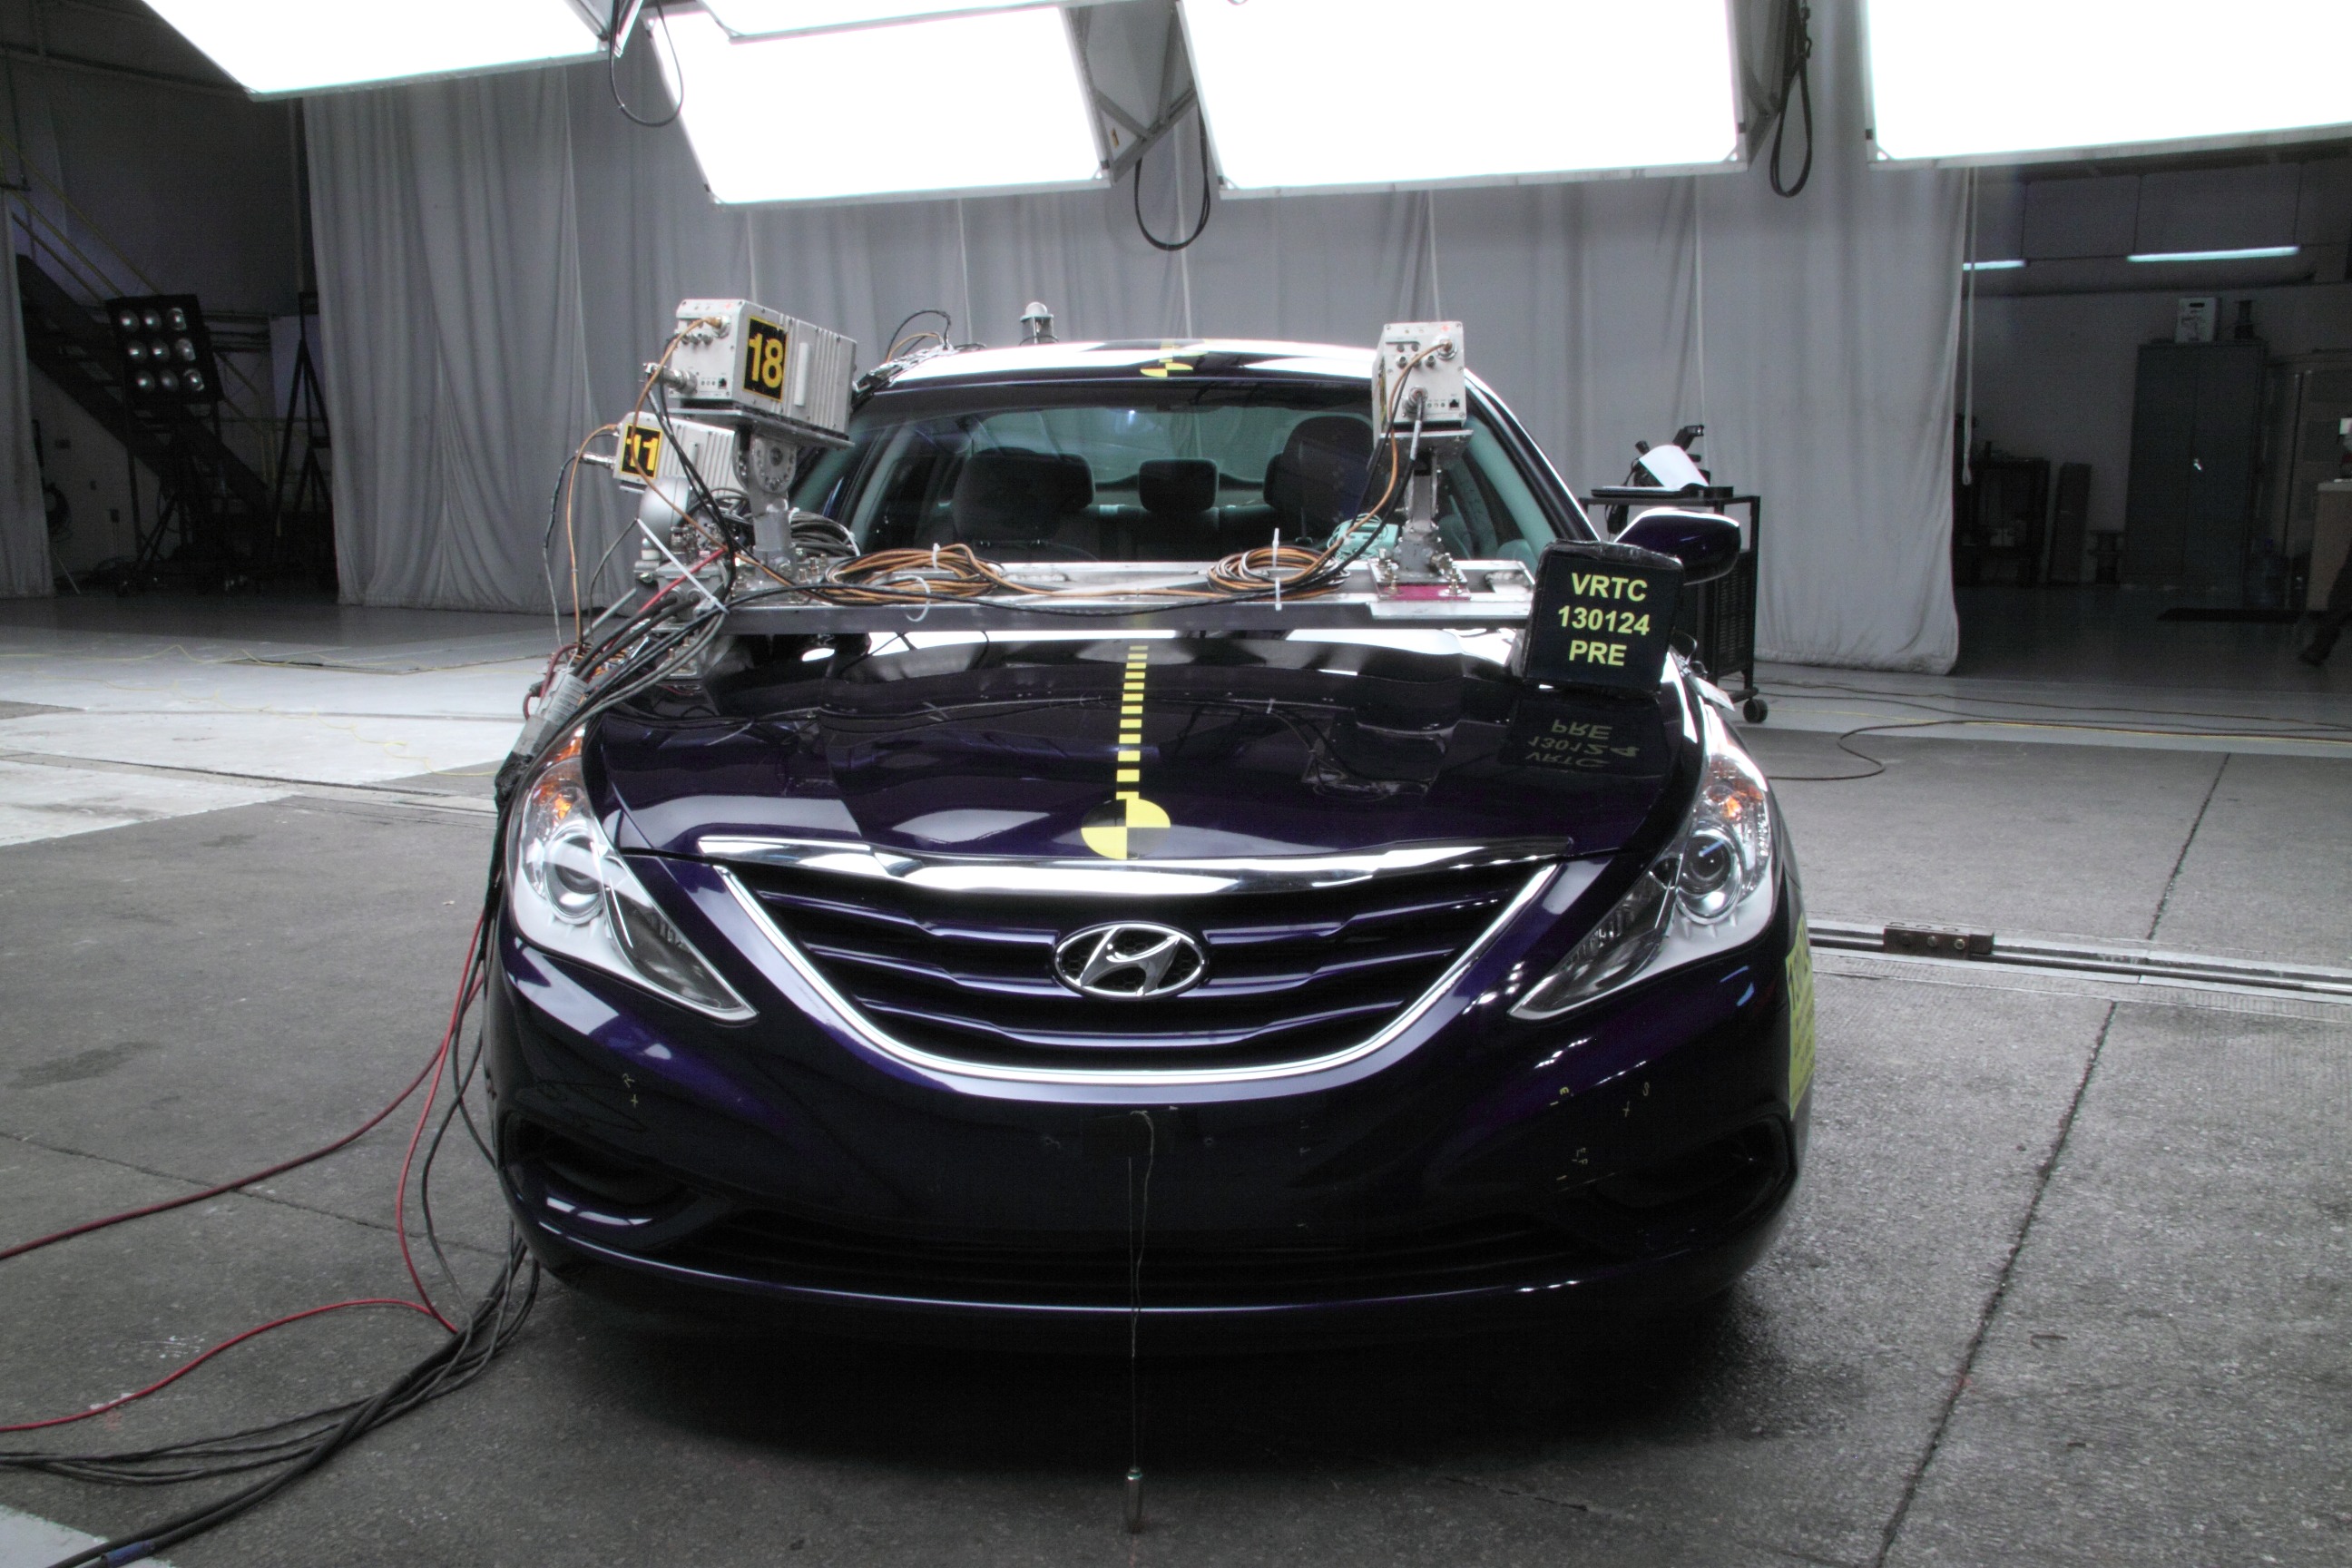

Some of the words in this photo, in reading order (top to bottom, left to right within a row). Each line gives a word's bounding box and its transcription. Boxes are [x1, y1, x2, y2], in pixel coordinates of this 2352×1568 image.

[748, 332, 784, 388] 18
[1571, 573, 1648, 602] VRTC
[1558, 605, 1651, 635] 130124
[1568, 639, 1627, 666] PRE
